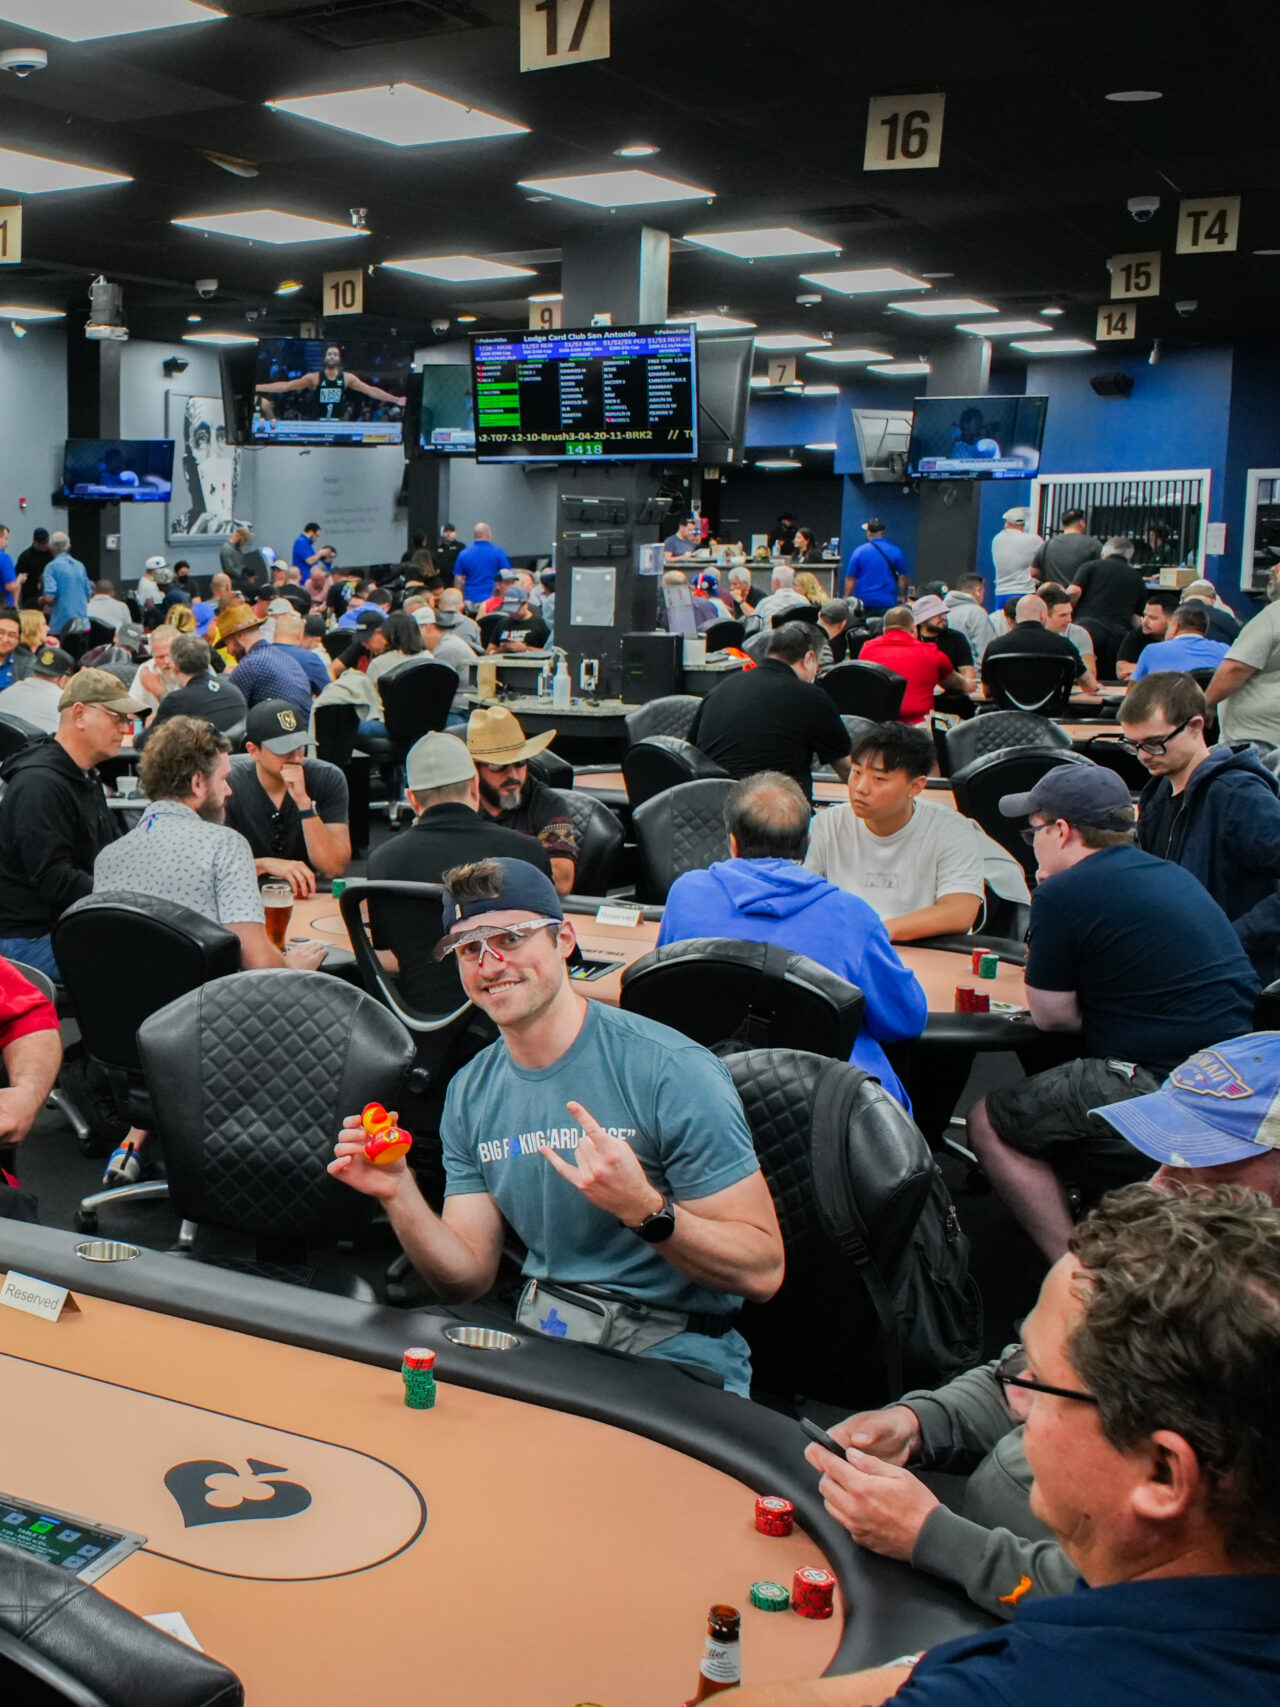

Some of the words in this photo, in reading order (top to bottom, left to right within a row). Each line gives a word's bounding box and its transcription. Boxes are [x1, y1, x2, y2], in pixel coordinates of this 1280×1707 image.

[880, 110, 930, 161] 16
[1186, 209, 1229, 247] T4
[1120, 262, 1152, 293] 15
[330, 280, 356, 310] 10
[540, 307, 553, 329] 9
[1103, 312, 1128, 336] 14
[523, 335, 547, 343] Lodge
[548, 333, 567, 341] Card
[567, 332, 586, 340] Club
[603, 330, 637, 339] Antonio
[776, 364, 787, 383] 7
[478, 1139, 502, 1163] BIG
[4, 1283, 60, 1310] Reserved
